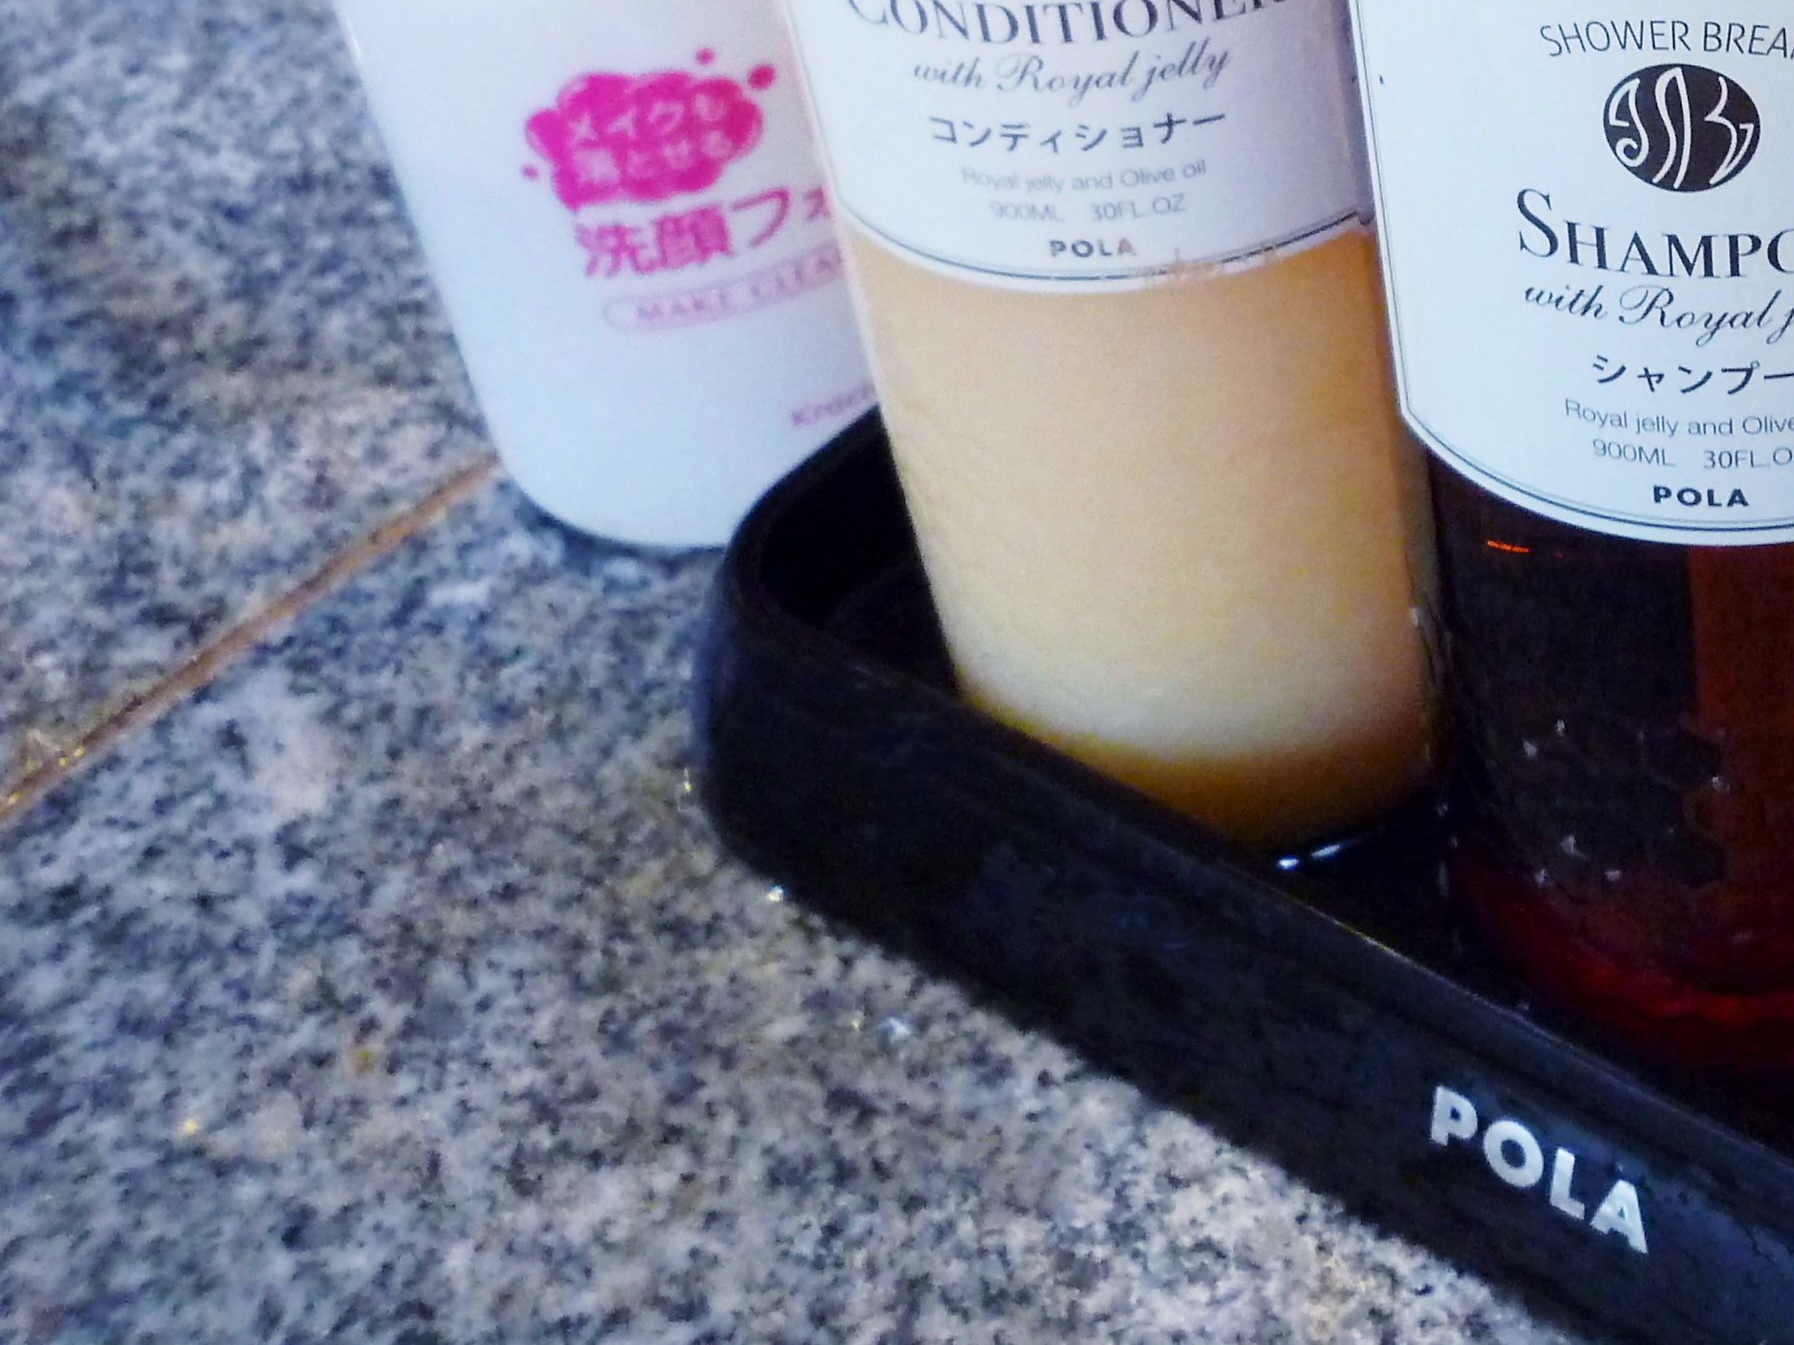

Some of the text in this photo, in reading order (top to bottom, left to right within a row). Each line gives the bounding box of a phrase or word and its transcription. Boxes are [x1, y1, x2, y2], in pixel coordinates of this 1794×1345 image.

[1539, 20, 1691, 58] SHOWER
[913, 37, 1229, 108] with Royal jelly
[929, 111, 1226, 155] コンディショナー
[1072, 170, 1113, 190] and
[1120, 166, 1176, 188] Olive
[1182, 159, 1207, 179] oil
[1049, 238, 1137, 259] POLA
[1523, 284, 1609, 321] with
[1618, 284, 1782, 348] Royal
[1564, 398, 1629, 432] Royal
[1635, 414, 1679, 437] jelly
[1687, 415, 1734, 436] and
[1592, 438, 1677, 469] 900ML
[1651, 485, 1751, 509] POLA
[1429, 1084, 1649, 1255] POLA
